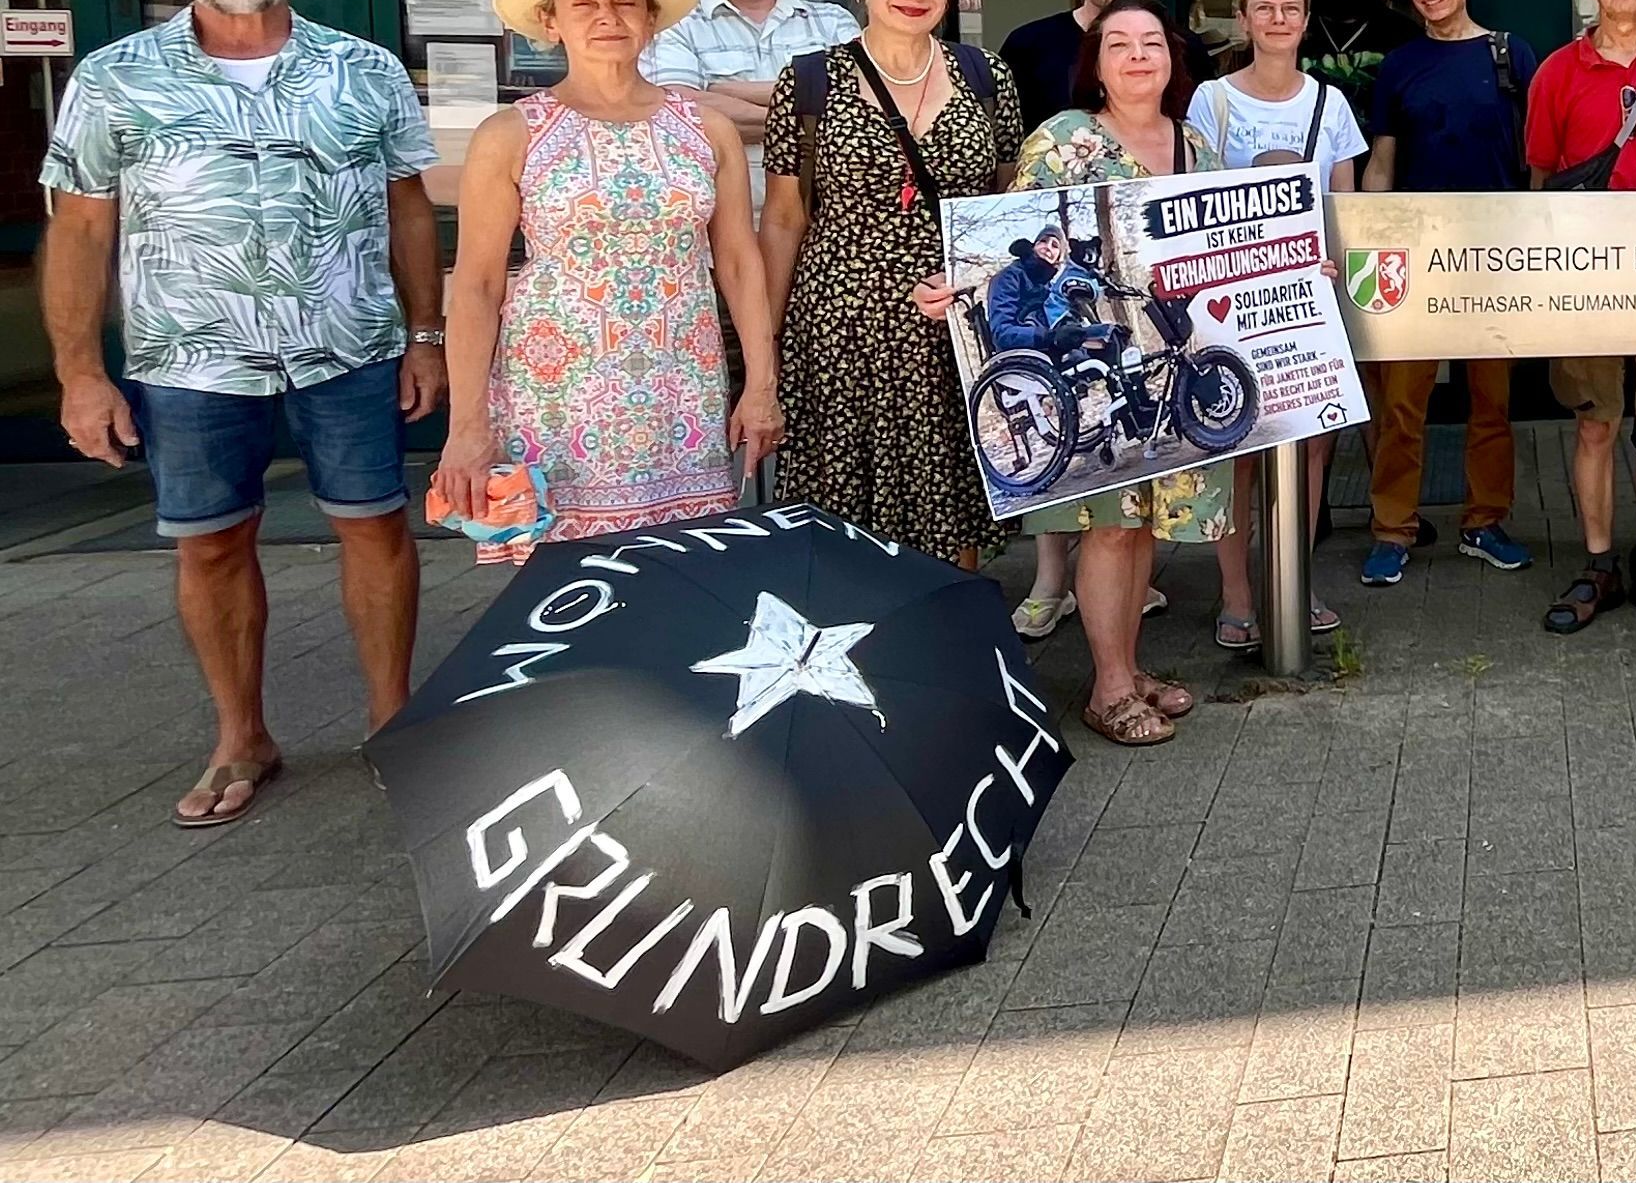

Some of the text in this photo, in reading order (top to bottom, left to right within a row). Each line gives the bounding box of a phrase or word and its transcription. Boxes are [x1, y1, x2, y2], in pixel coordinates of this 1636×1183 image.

[5, 17, 66, 35] Eingang
[1160, 180, 1303, 234] EIN ZUHAUSE
[1206, 224, 1264, 249] IST KEINE
[1159, 237, 1318, 292] VERHANDLUNGSMASSE.
[1427, 246, 1626, 273] AMTSGERICHT
[1234, 278, 1314, 310] SOLIDARITÄT
[1428, 295, 1532, 314] BALTHASAR
[1549, 294, 1636, 311] NEUMANN
[1237, 301, 1322, 331] MIT JANETTE.
[1251, 341, 1298, 360] GEMEINSAM
[1255, 360, 1273, 373] SIND
[1275, 356, 1291, 368] WIR
[1292, 351, 1318, 365] STARK
[1260, 357, 1345, 387] FÜR JANETTE UND FÜR
[1262, 375, 1338, 402] DAS RECHT AUF EIN
[1263, 399, 1301, 415] SICHERES
[466, 645, 1060, 1024] GRUNDRECHT
